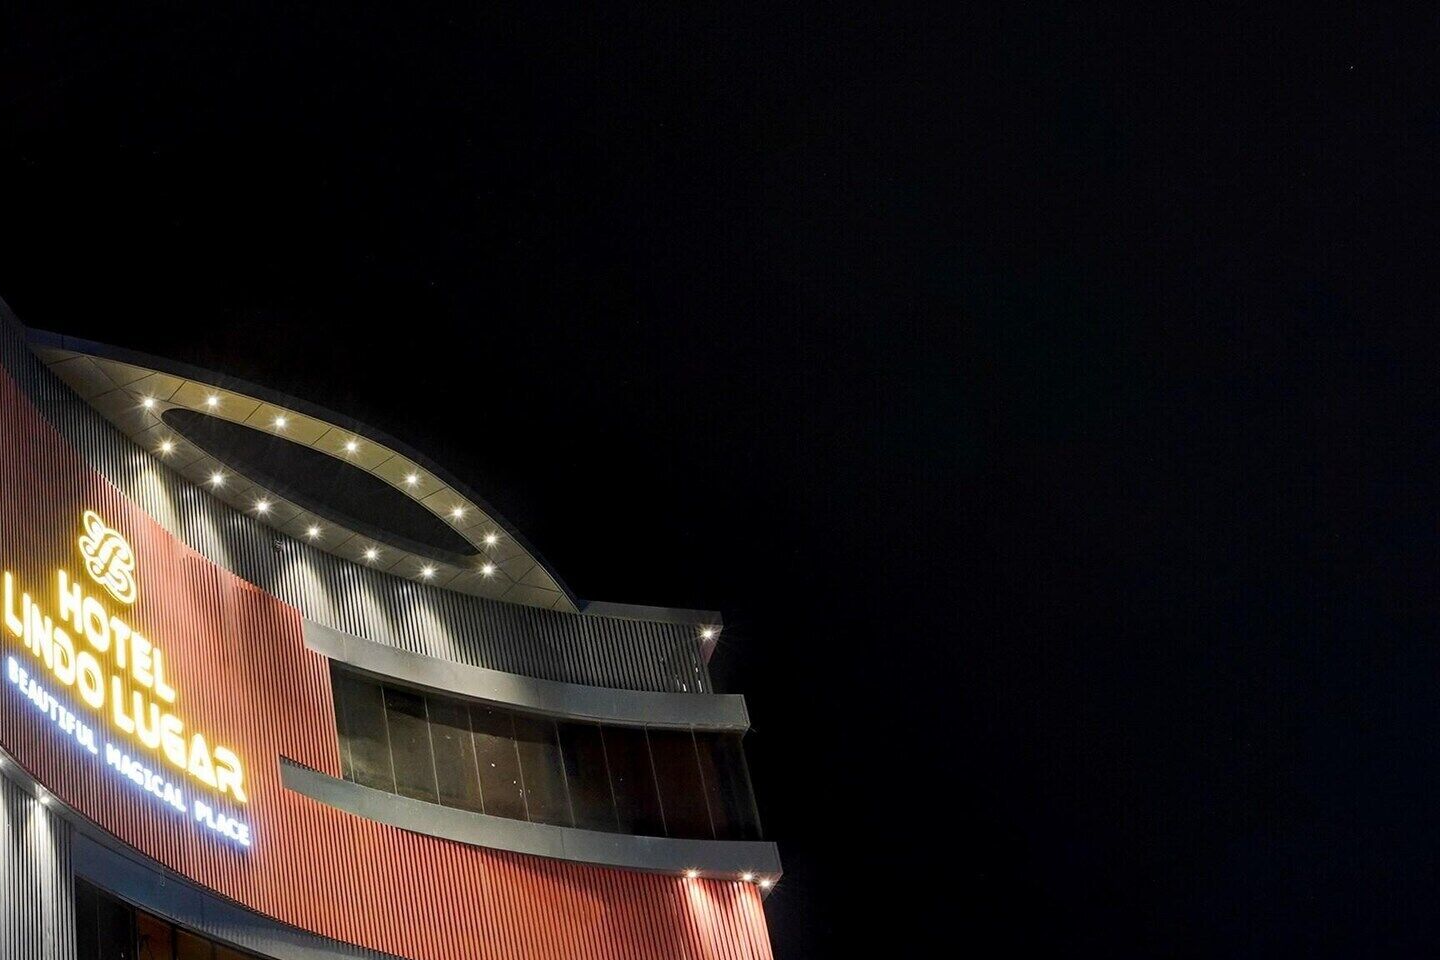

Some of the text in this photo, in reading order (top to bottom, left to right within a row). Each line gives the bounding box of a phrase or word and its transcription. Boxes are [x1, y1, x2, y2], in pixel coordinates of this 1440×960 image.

[4, 571, 247, 803] LINDO LUGAR
[58, 569, 175, 703] HOTEL
[8, 656, 251, 846] BEAUTIFUL MAGICAL PLACE
